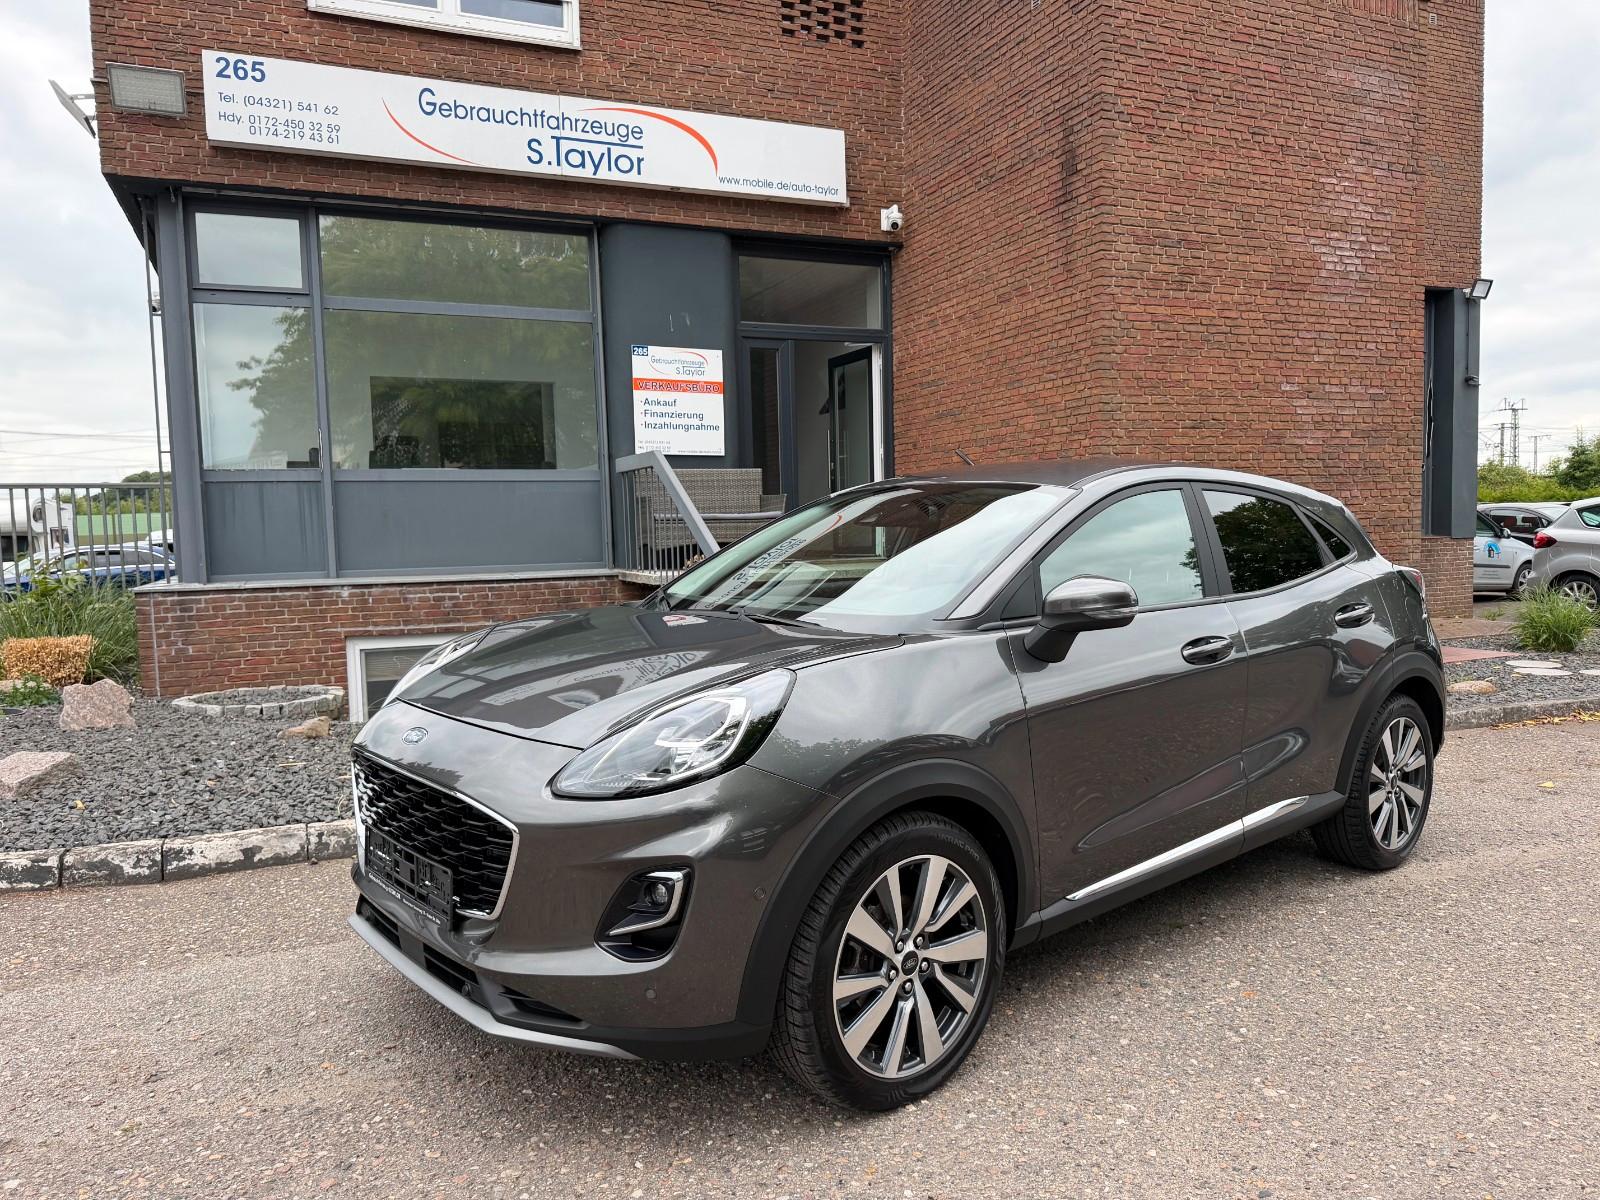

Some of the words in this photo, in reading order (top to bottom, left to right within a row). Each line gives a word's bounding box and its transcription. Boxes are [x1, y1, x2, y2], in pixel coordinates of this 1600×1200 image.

[215, 56, 266, 83] 265
[218, 92, 239, 104] Tel.
[243, 95, 293, 112] (04321)
[297, 102, 319, 114] 541
[324, 105, 339, 116] 62
[418, 87, 644, 142] Gebrauchtfahrzeuge
[218, 111, 243, 125] Hdy.
[248, 114, 305, 130] 0172-450
[309, 121, 324, 132] 32
[327, 123, 341, 134] 59
[249, 125, 305, 141] 0174-219
[309, 132, 324, 143] 43
[327, 134, 340, 145] 61
[527, 135, 644, 176] S.Taylor
[718, 175, 839, 196] www.mobile.de/auto-taylor
[633, 347, 648, 355] 265
[643, 398, 677, 407] Ankauf
[644, 410, 704, 421] Finanzierung
[644, 421, 720, 432] Inzahlungnahme
